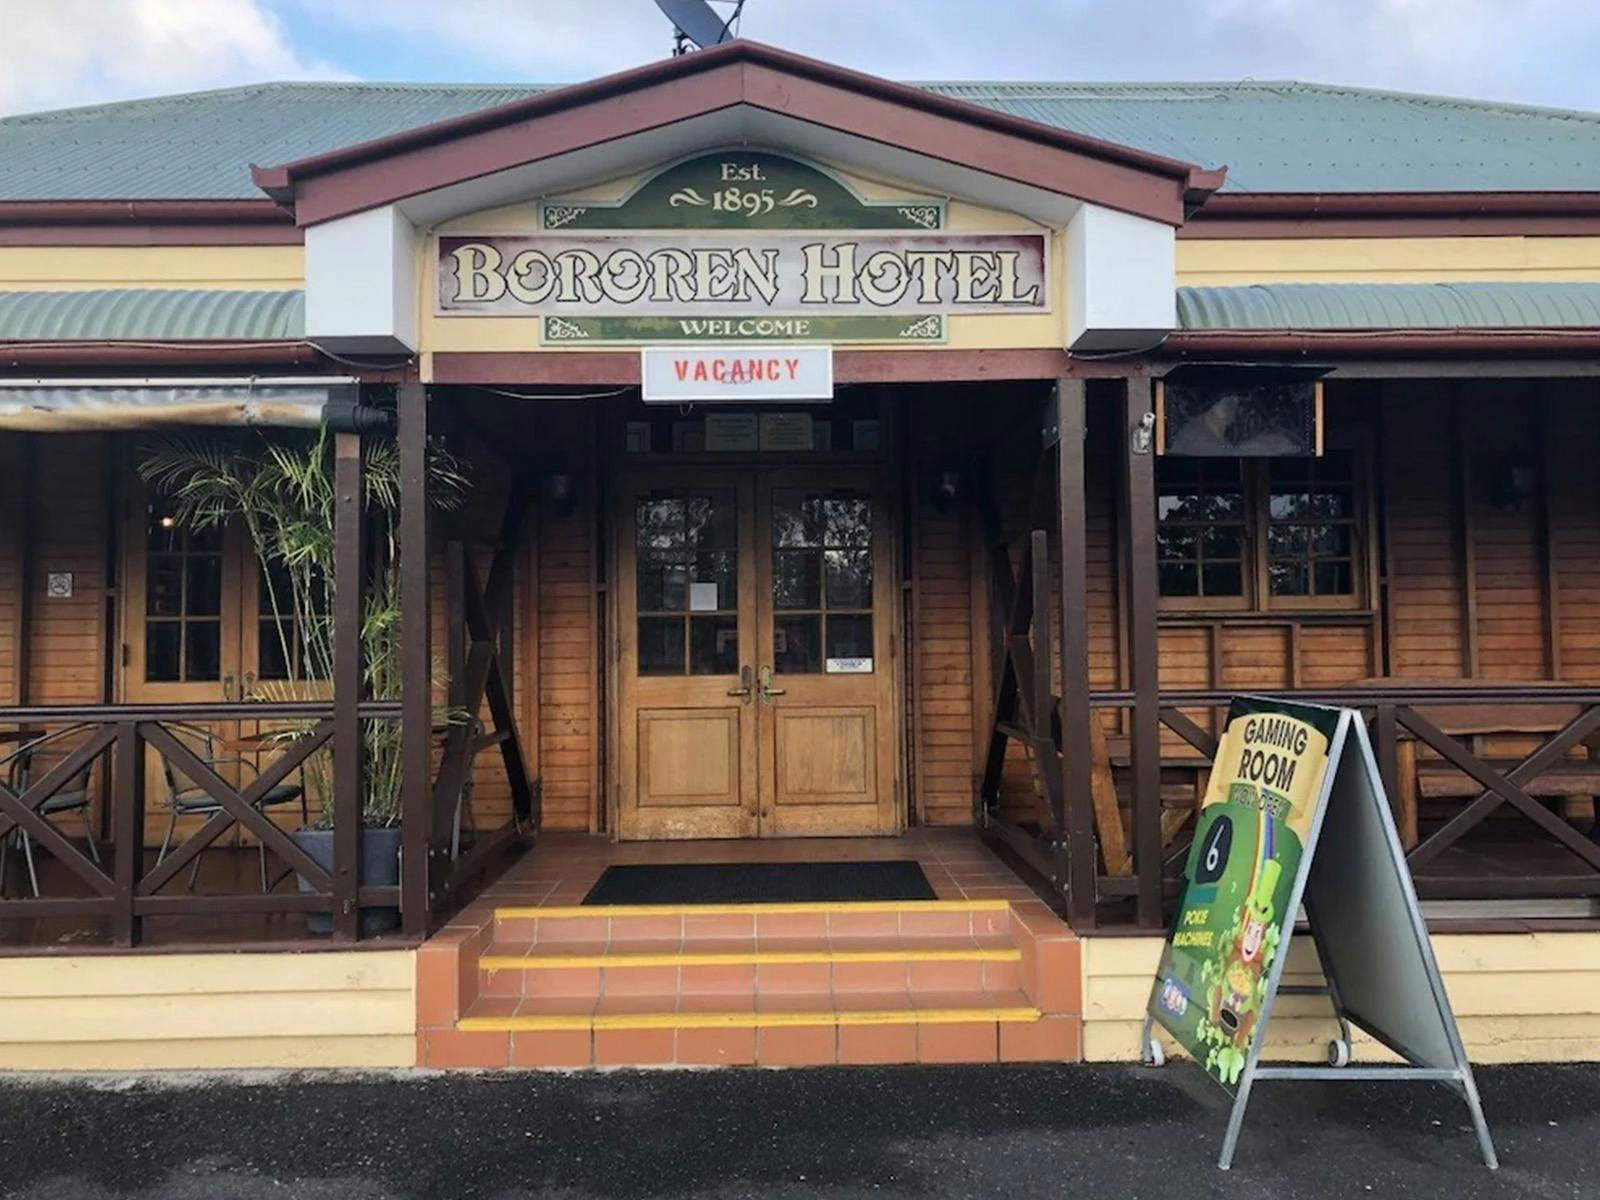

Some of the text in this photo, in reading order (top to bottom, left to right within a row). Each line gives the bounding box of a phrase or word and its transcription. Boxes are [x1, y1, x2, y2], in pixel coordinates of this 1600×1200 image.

[720, 162, 767, 181] Est.
[712, 187, 775, 217] 1895
[449, 242, 1039, 306] BOROREN HOTEL
[679, 319, 810, 336] WELCOME
[674, 359, 799, 382] VACANCY
[1243, 718, 1308, 757] GAMING
[1237, 748, 1297, 793] ROOM
[1206, 824, 1225, 872] 6
